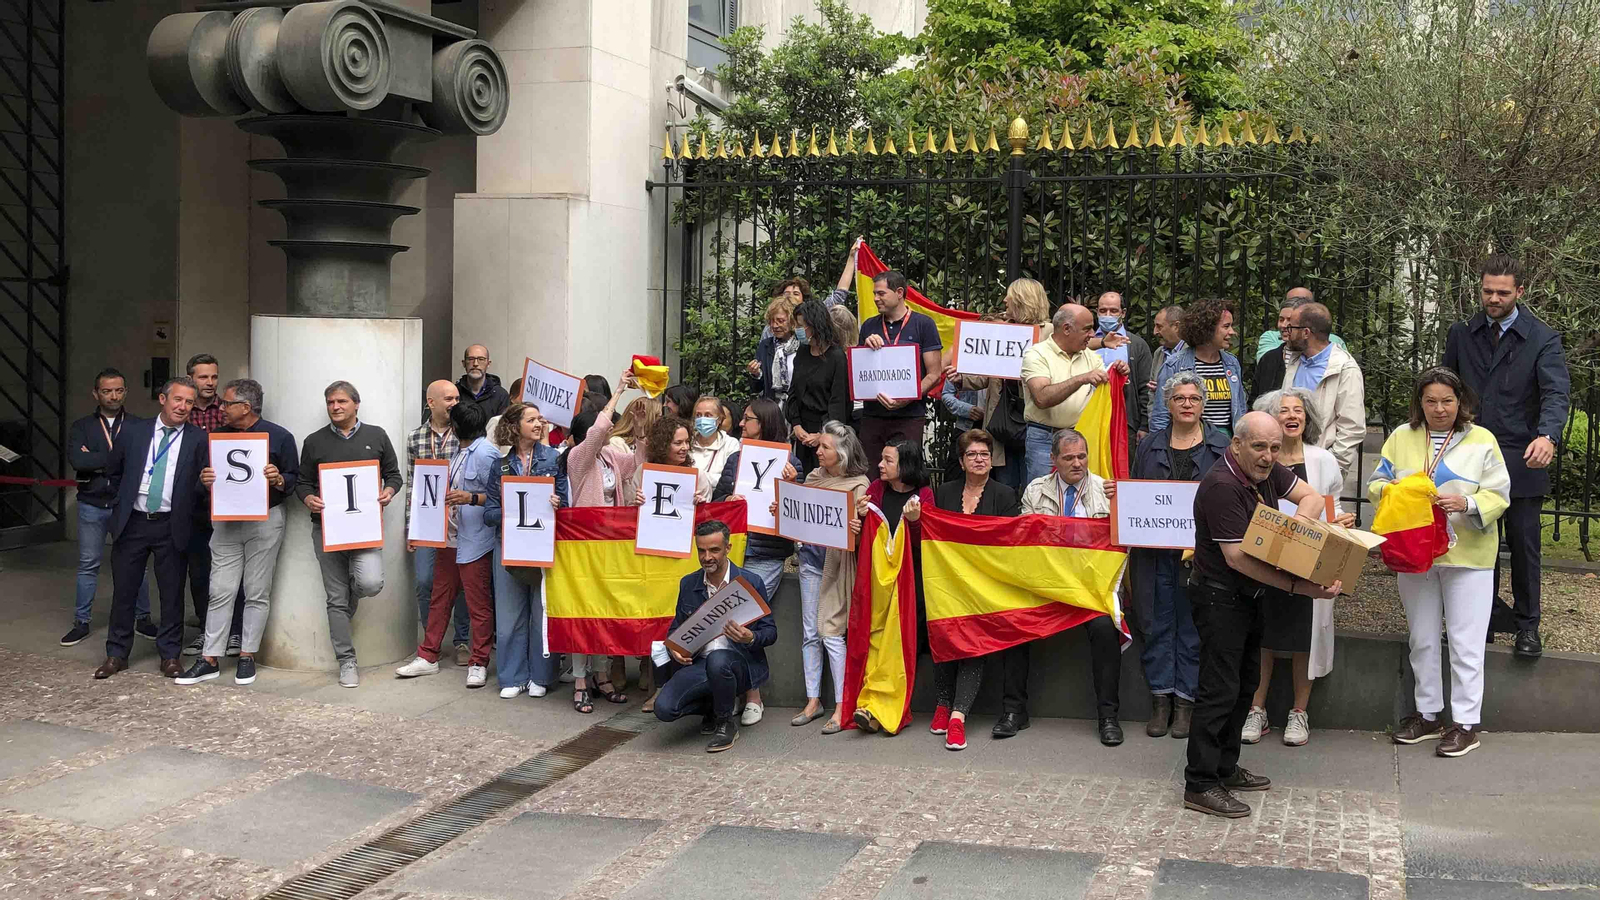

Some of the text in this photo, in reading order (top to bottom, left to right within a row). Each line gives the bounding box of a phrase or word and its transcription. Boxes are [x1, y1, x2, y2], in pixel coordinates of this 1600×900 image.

[964, 337, 1030, 358] SIN LEY
[526, 375, 573, 410] SIN INDEX
[858, 368, 911, 382] ABANDONADOS
[225, 448, 255, 485] S
[751, 457, 778, 492] Y
[342, 473, 362, 514] I
[421, 474, 441, 509] N
[651, 481, 683, 520] E
[1154, 494, 1173, 506] SIN
[515, 490, 545, 531] L
[783, 496, 844, 528] SIN INDEX
[1254, 536, 1264, 546] D
[1290, 523, 1323, 541] OUVRIR
[680, 590, 749, 644] SIN INDEX
